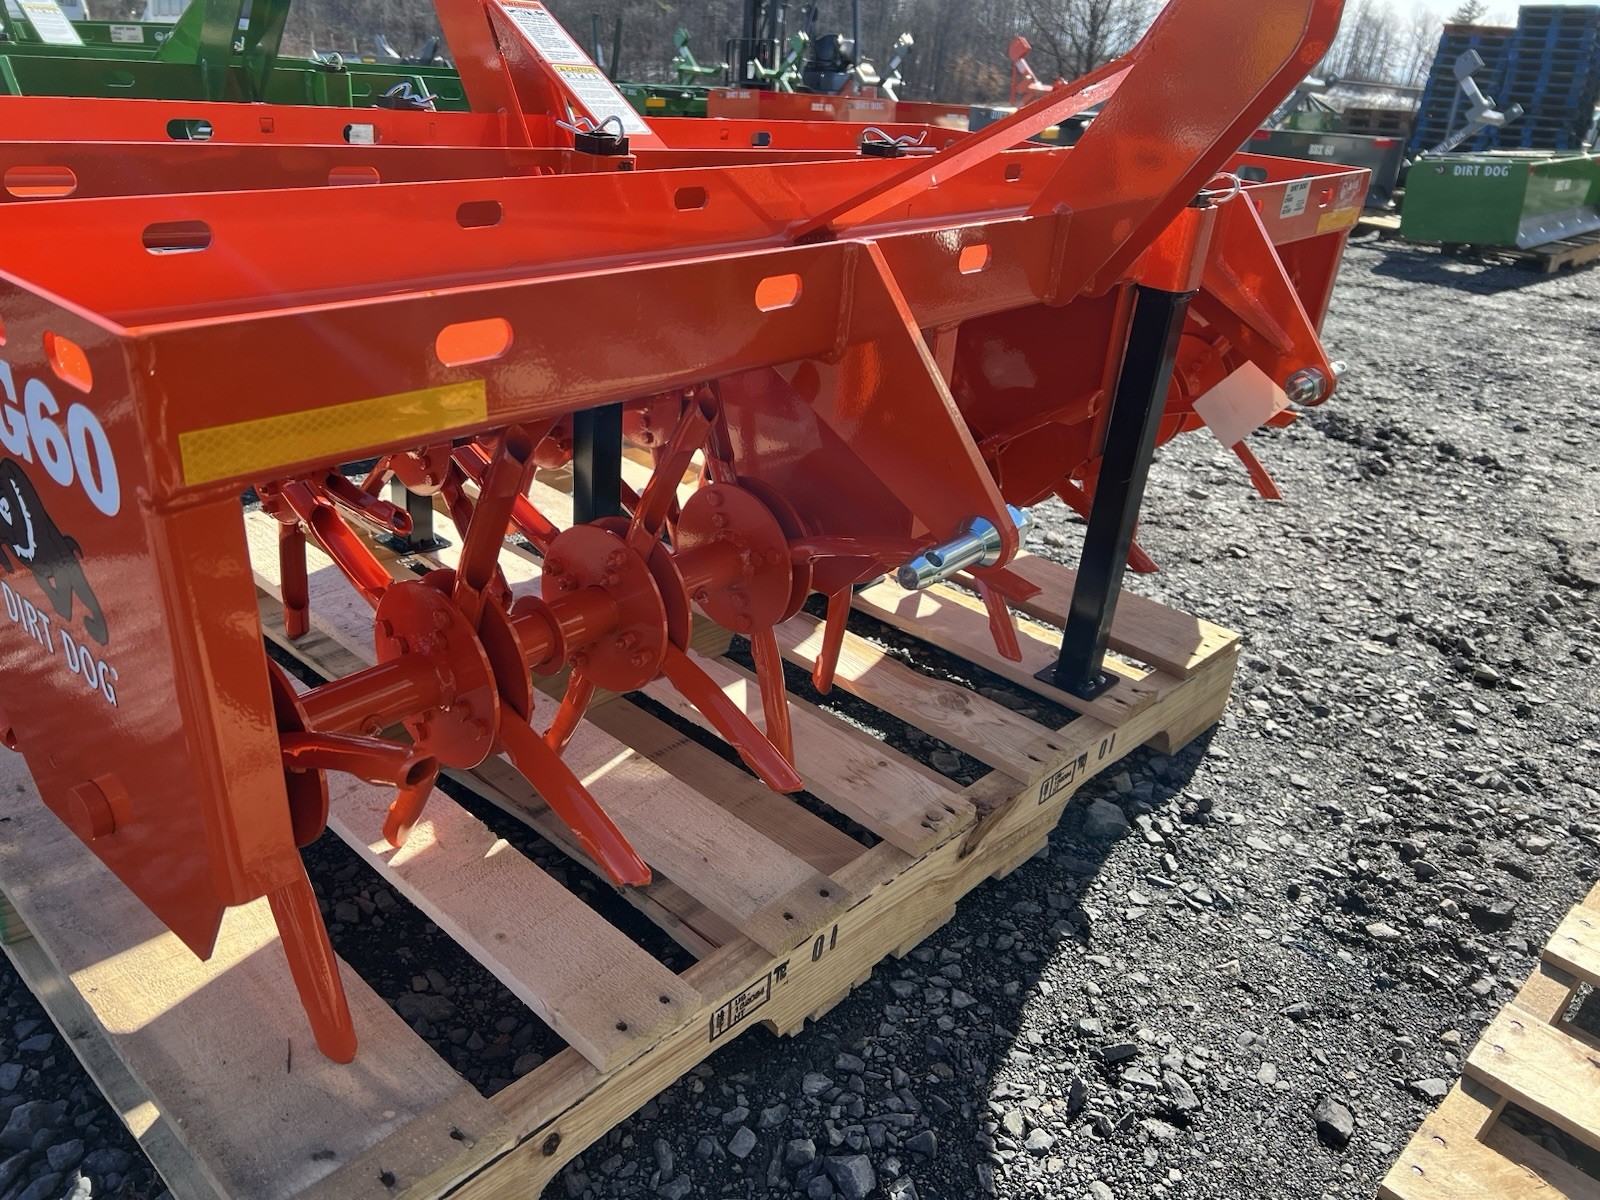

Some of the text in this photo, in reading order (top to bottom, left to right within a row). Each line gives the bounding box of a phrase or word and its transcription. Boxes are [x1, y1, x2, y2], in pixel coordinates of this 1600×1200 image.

[1453, 165, 1510, 177] DIRT DOG
[0, 581, 118, 708] DIRT DOG
